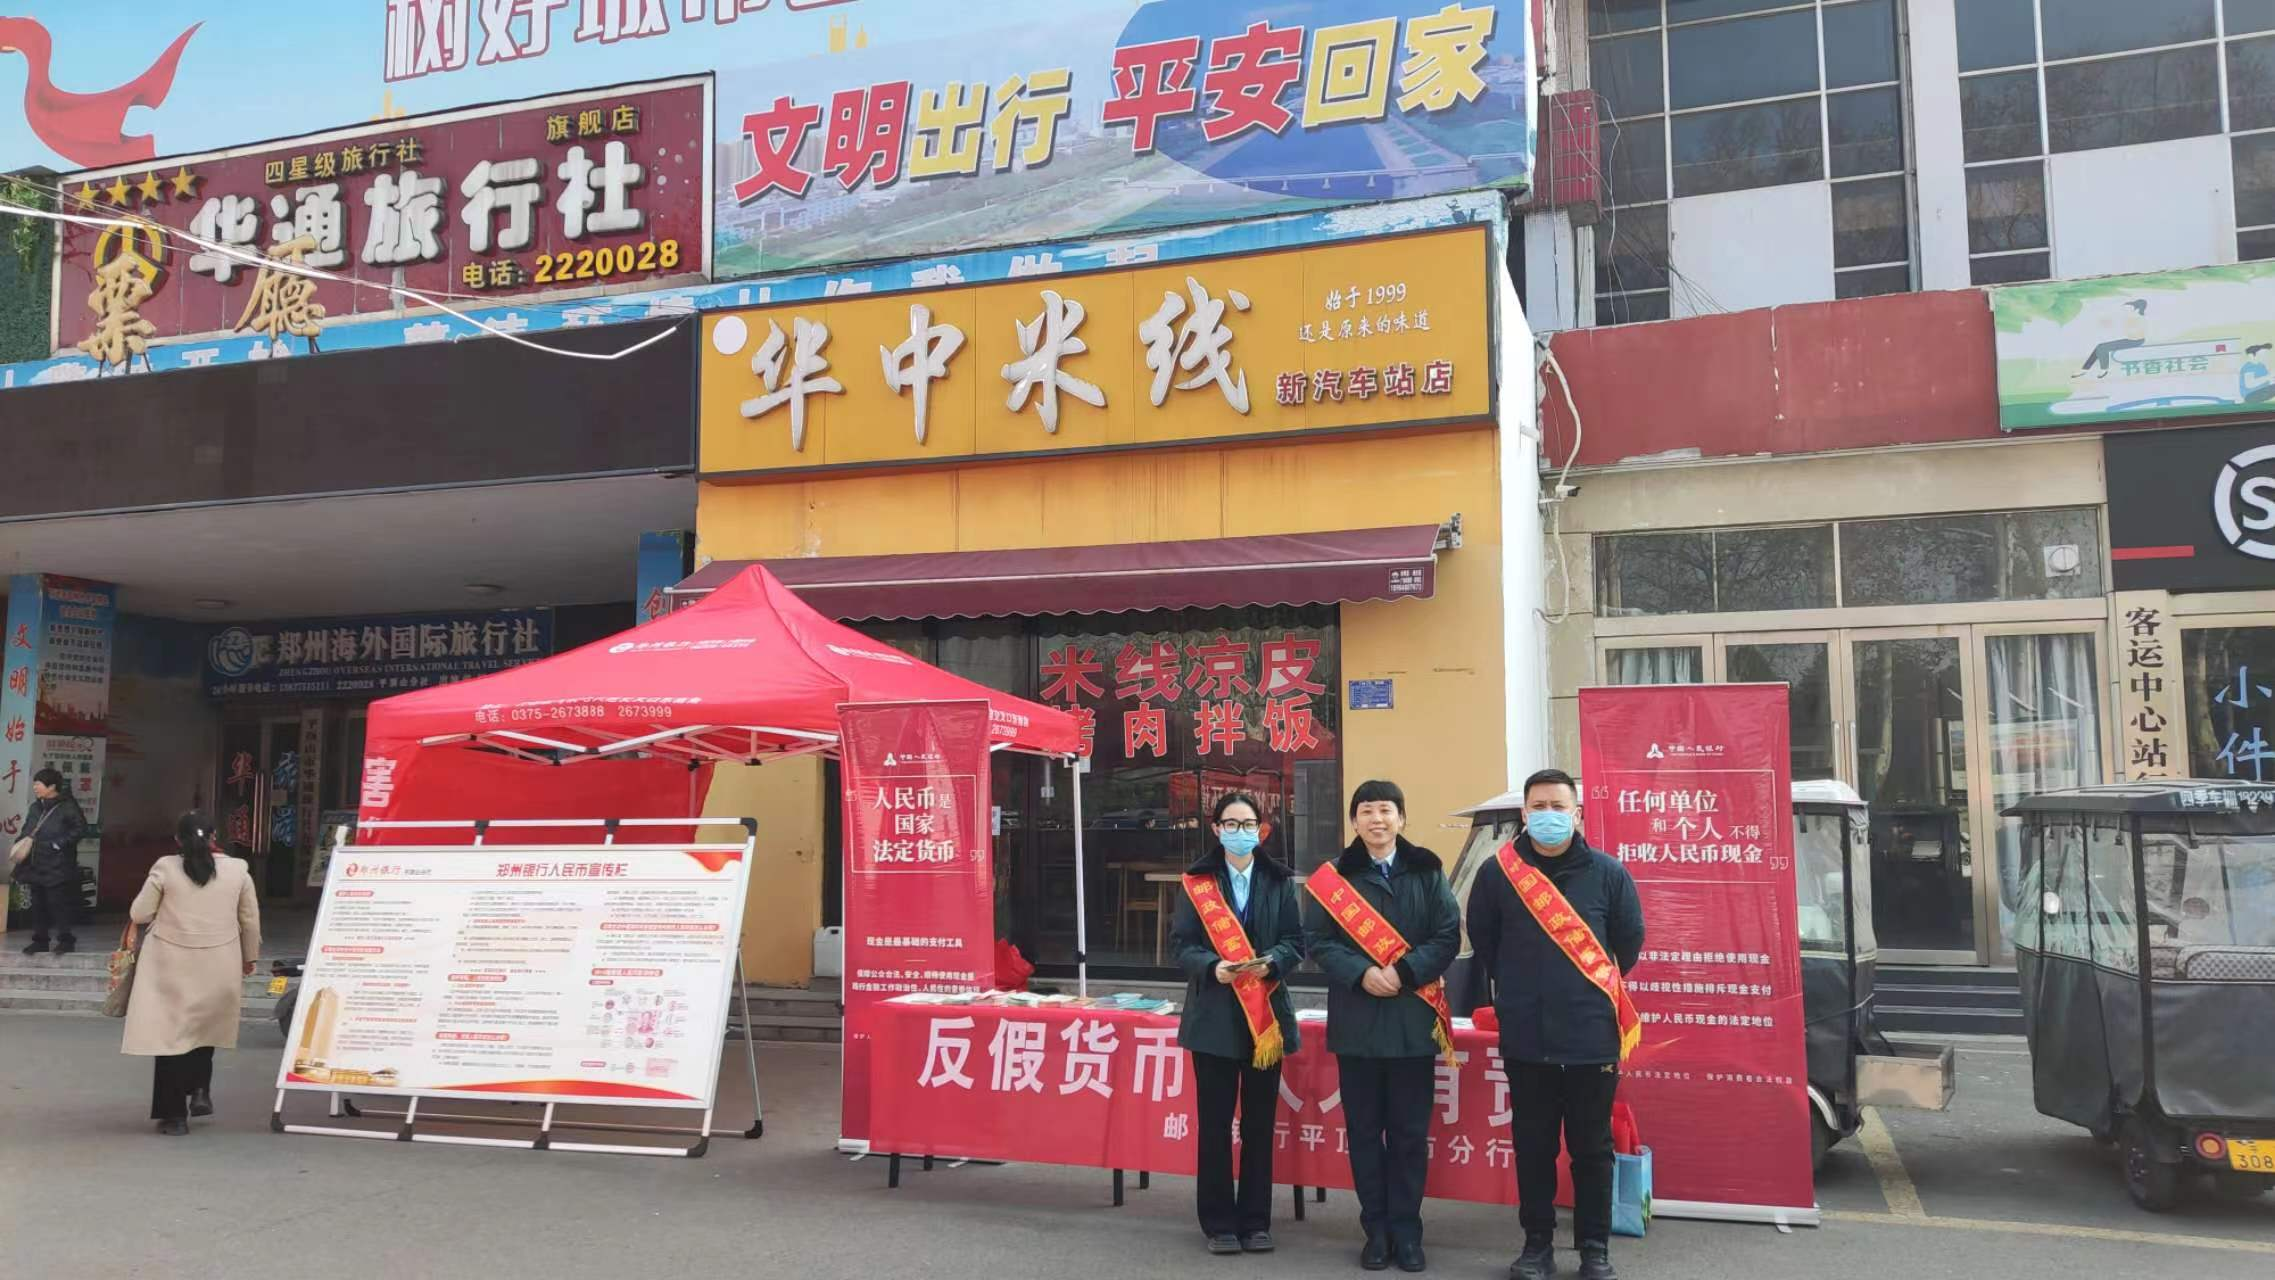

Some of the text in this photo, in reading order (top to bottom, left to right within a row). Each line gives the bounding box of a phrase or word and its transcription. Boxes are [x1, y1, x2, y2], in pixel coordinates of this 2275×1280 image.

[734, 3, 1496, 205] 文明出行 平安回家
[546, 104, 640, 142] 旗舰店
[264, 138, 421, 186] 四星级旅行社
[188, 140, 644, 282] 华通旅行社
[1298, 309, 1431, 344] 还是原来的味道
[740, 276, 1253, 452] 华中米线
[2120, 355, 2209, 377] 书香社会
[1276, 360, 1454, 406] 新汽车站店
[277, 620, 539, 665] 郑州海外国际旅行社
[1038, 632, 1328, 703] 米线凉皮
[618, 705, 673, 719] 2673999
[873, 785, 951, 810] 人民币是
[1617, 789, 1719, 814] 任何单位
[895, 813, 935, 835] 国家
[872, 839, 955, 863] 法定货币
[1616, 842, 1763, 864] 拒收人民币现金
[496, 863, 628, 878] 郑州银行人民币宣传栏
[917, 1015, 1185, 1103] 反假货币
